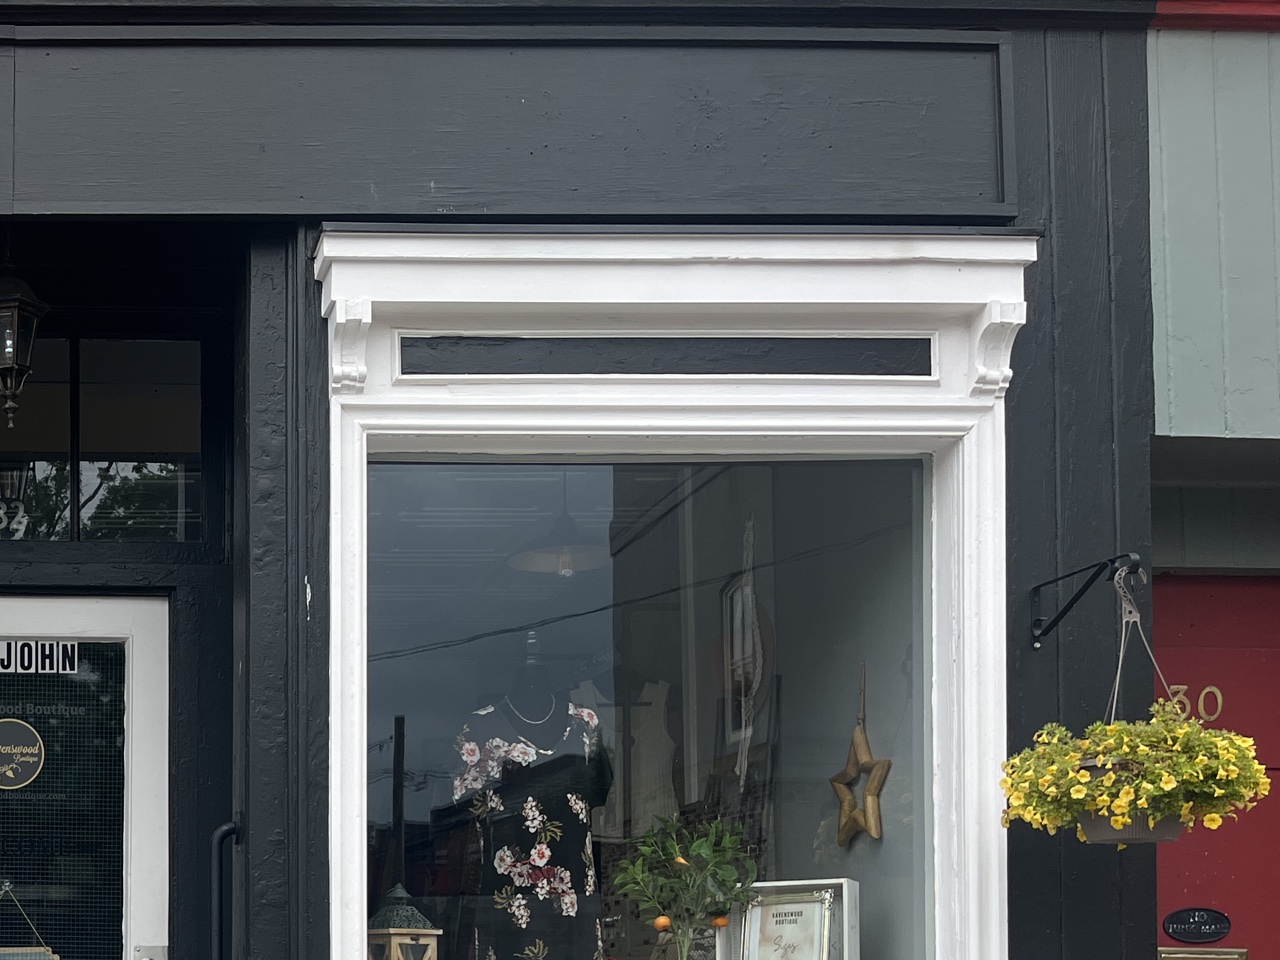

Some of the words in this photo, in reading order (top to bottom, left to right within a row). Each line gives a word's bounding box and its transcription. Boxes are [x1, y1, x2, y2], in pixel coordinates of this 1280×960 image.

[0, 641, 76, 672] JOHN
[26, 702, 87, 717] Boutique
[1168, 685, 1222, 722] 30
[13, 754, 38, 763] Boutique
